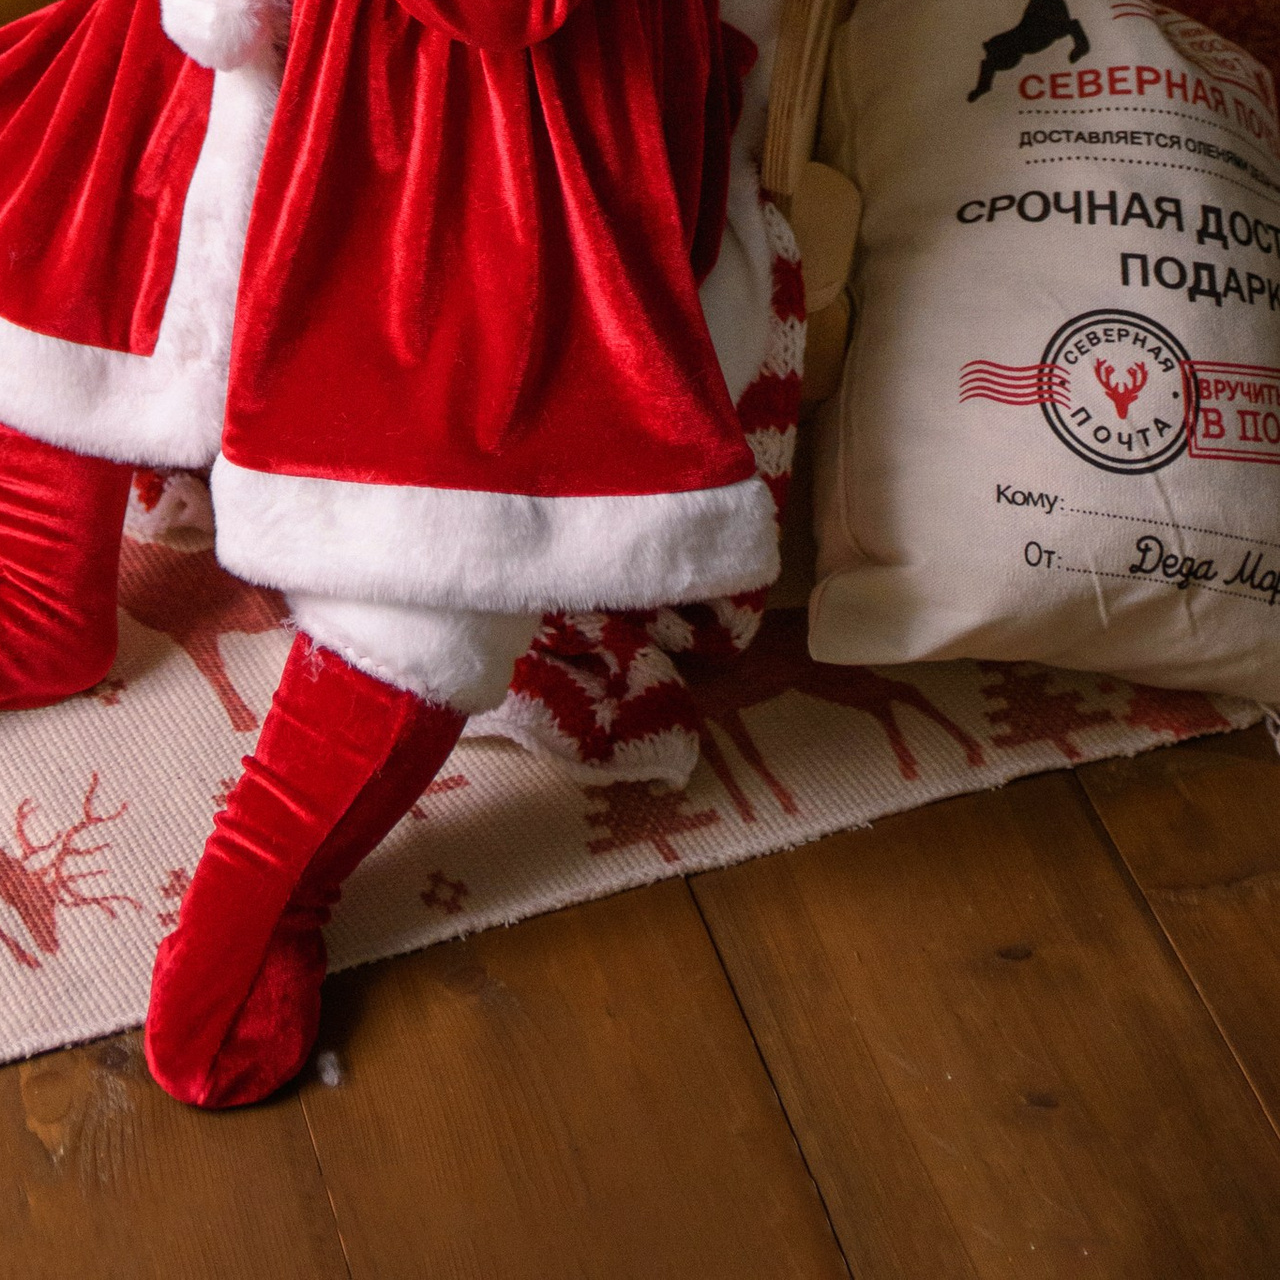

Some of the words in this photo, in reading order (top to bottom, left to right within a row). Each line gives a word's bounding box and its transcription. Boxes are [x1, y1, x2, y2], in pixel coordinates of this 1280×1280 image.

[1019, 65, 1230, 119] СЕВЕРНАЯ
[1019, 129, 1182, 150] ДОСТАВЛЯЕТСЯ
[956, 190, 1185, 233] СРОЧНАЯ
[1062, 327, 1176, 374] СЕВЕРНАЯ
[1070, 405, 1172, 453] ПОЧТА
[1199, 407, 1226, 439] В
[1129, 534, 1218, 590] Деда
